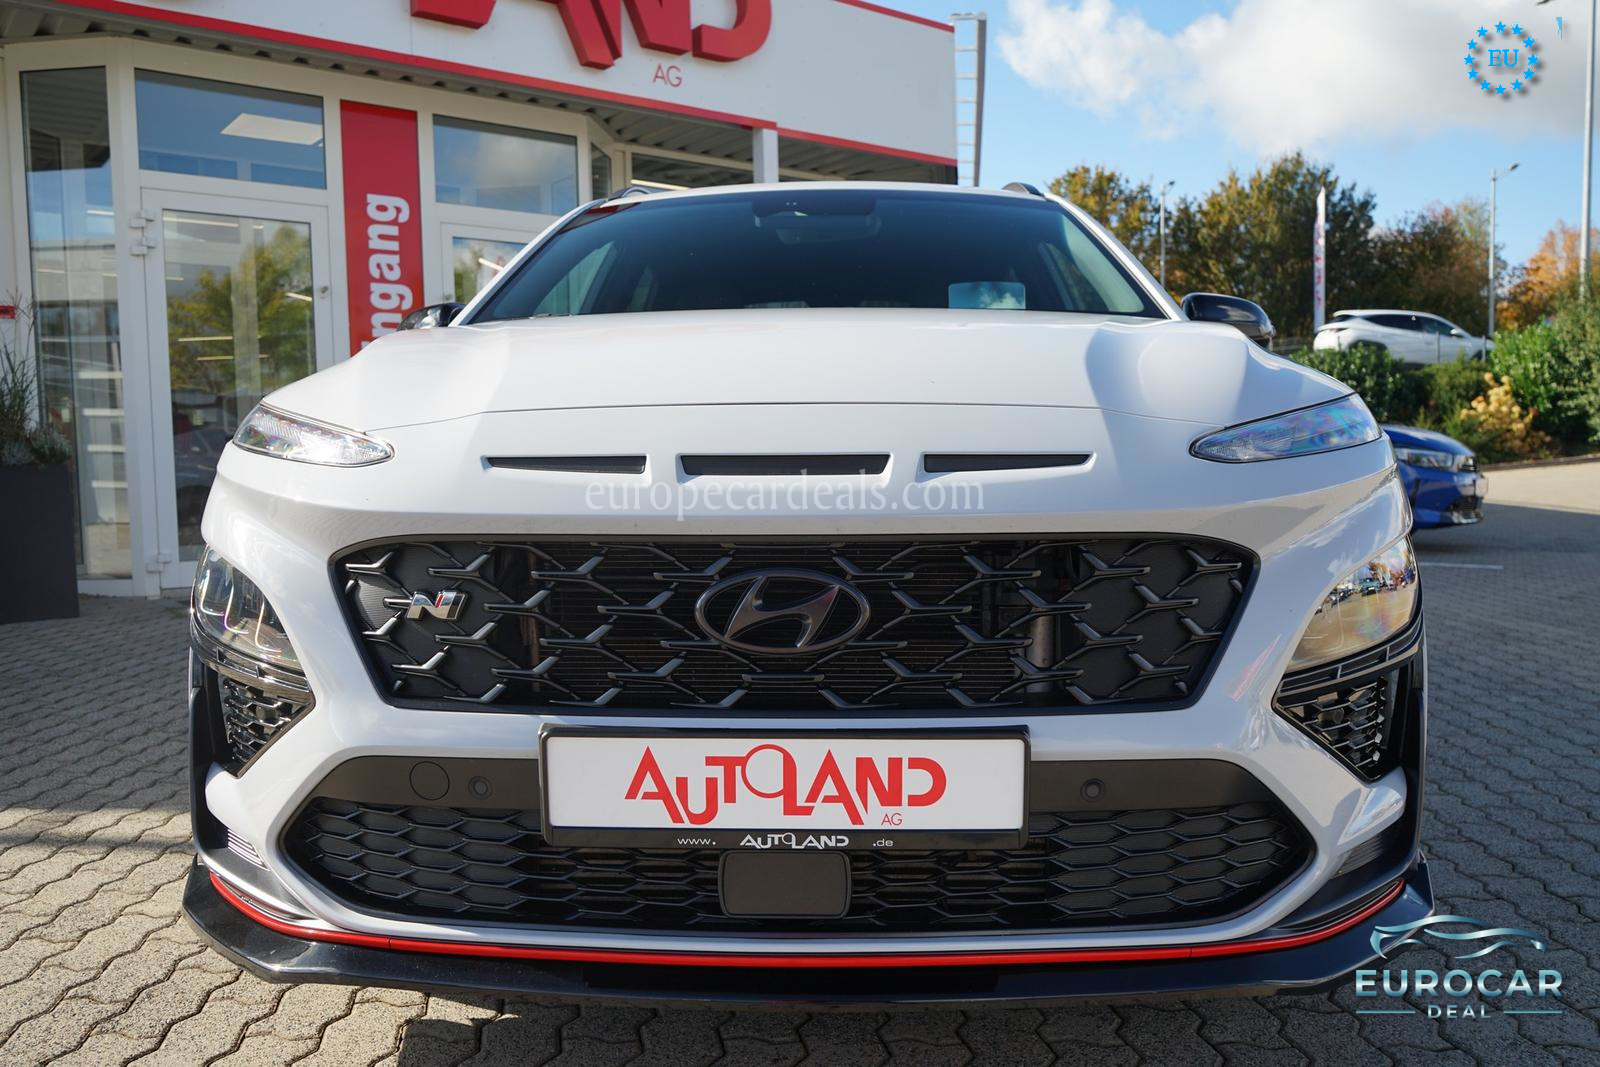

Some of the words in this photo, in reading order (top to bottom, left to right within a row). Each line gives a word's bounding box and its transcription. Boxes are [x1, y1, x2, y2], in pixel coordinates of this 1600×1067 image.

[652, 64, 682, 87] AG
[361, 193, 413, 350] ngang
[624, 743, 947, 826] AUTOLAND
[880, 813, 903, 827] AG
